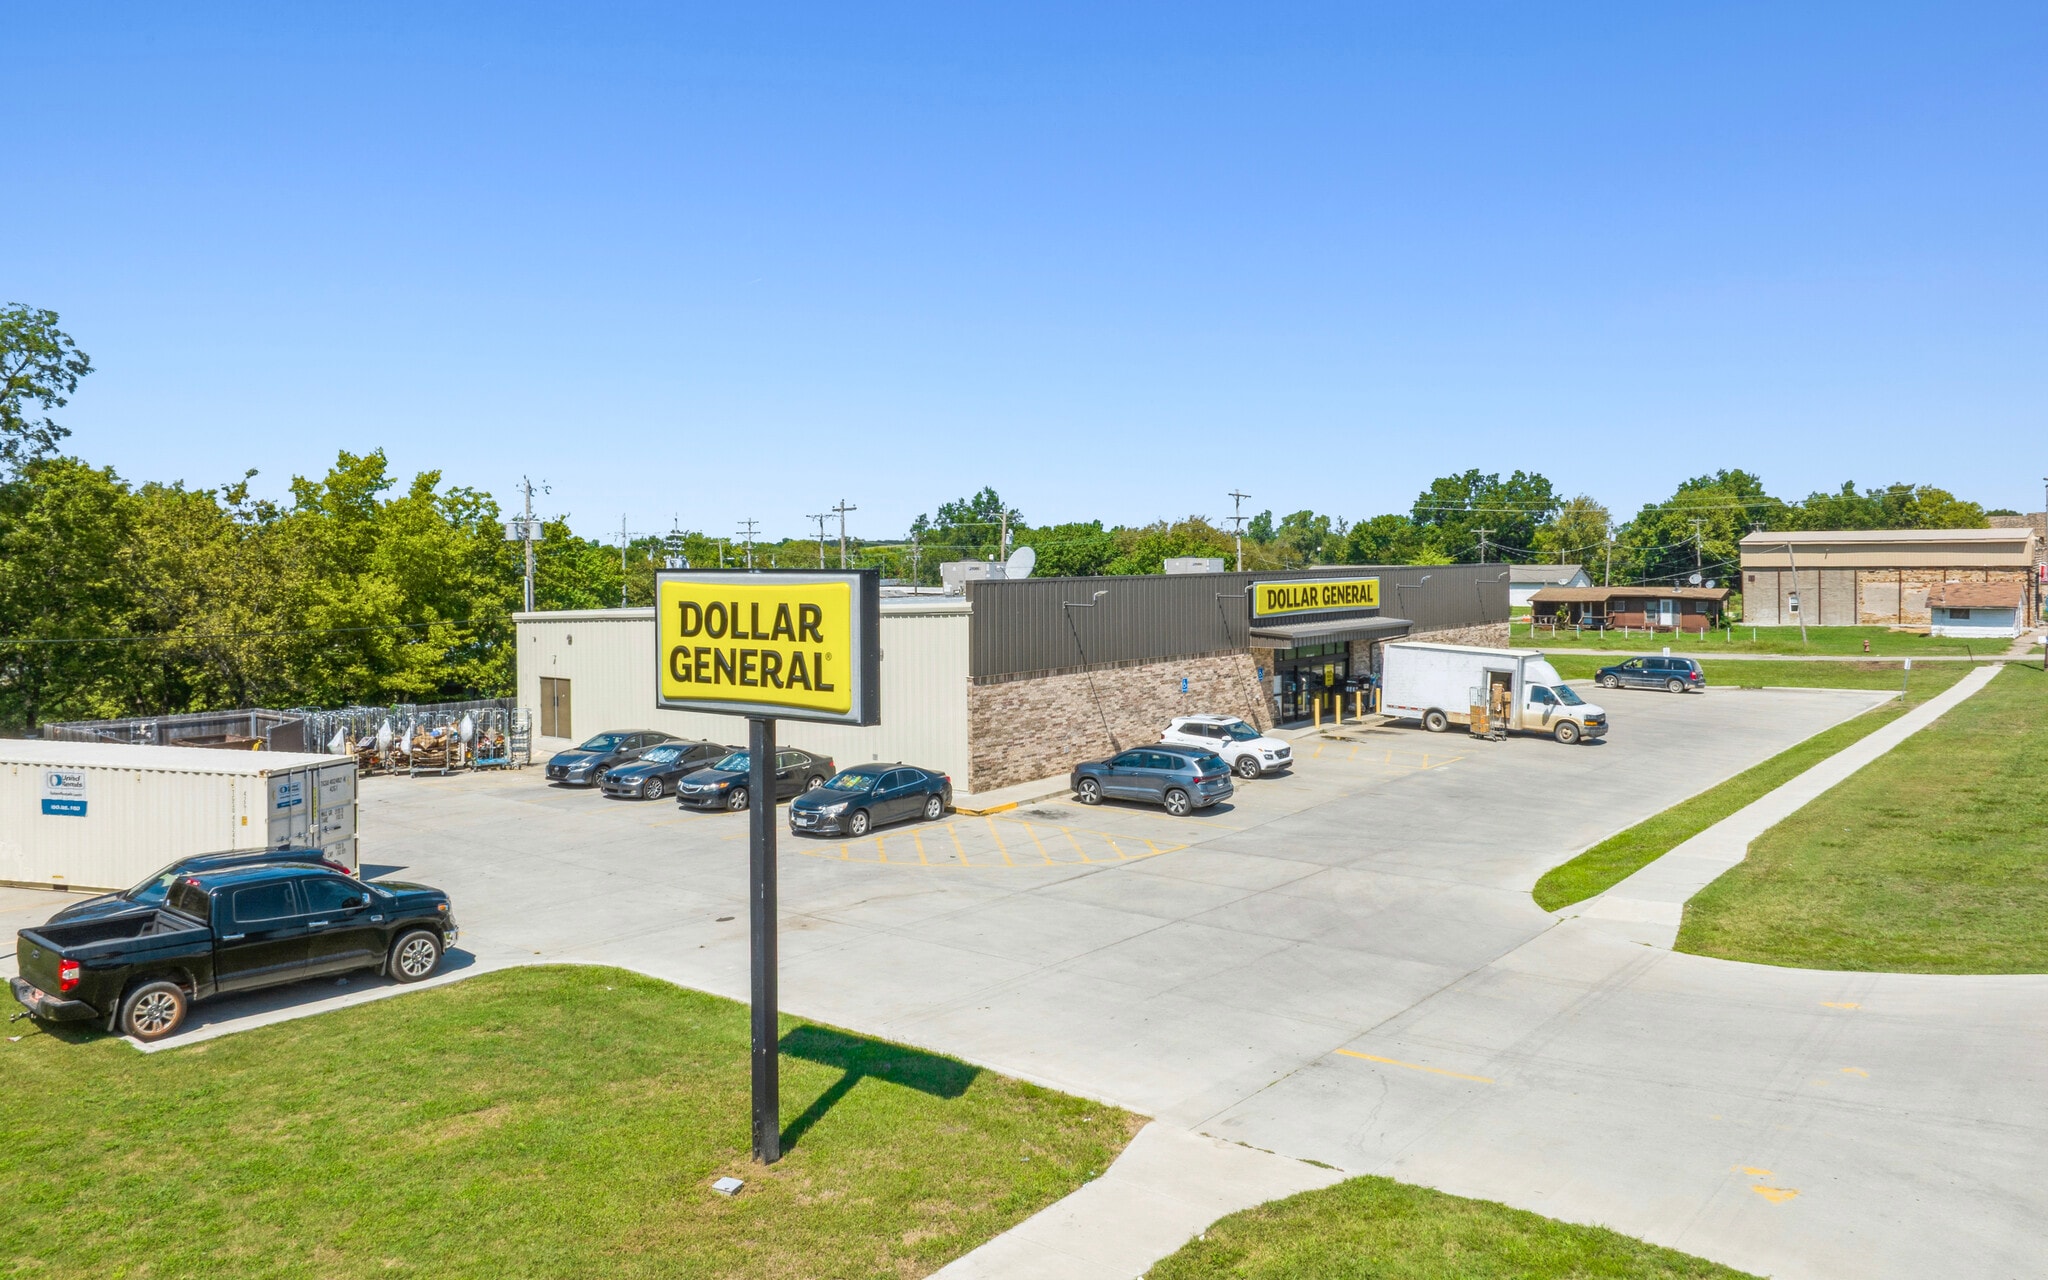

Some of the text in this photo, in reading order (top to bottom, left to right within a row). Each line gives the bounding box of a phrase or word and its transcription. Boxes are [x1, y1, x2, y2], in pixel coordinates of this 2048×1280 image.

[1267, 584, 1373, 609] DOLLAR GENERAL
[679, 601, 824, 643] DOLLAR
